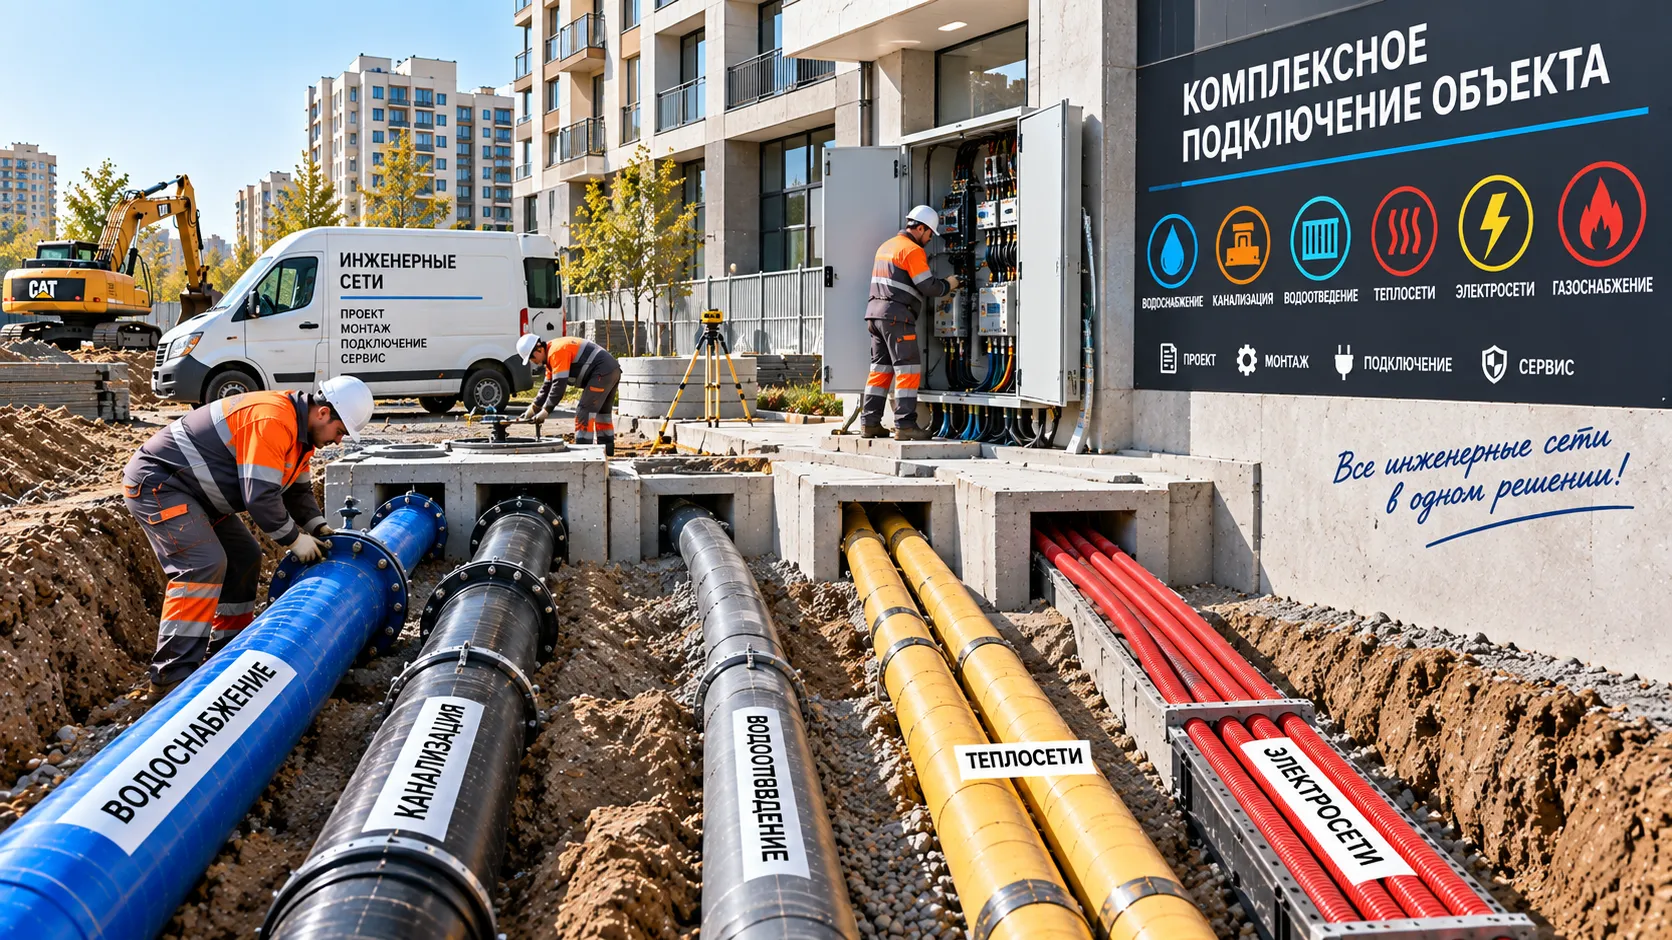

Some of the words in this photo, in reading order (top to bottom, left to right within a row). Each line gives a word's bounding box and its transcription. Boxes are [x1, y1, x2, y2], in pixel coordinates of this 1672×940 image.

[1183, 22, 1428, 116] КОМПЛЕКСНОЕ
[1182, 81, 1422, 163] ПОДКЛЮЧЕНИЕ
[1432, 42, 1611, 116] ОБЪЕКТА
[339, 251, 457, 270] ИНЖЕНЕРНЫЕ
[28, 279, 58, 299] CAT
[340, 273, 384, 290] СЕТИ
[1455, 281, 1535, 299] ЭЛЕКТРОСЕТИ
[1552, 276, 1654, 296] ГАЗОСНАБЖЕНИЕ
[1212, 292, 1274, 307] КАНАЛИЗАЦИЯ
[1283, 288, 1359, 306] ВОДООТВЕДЕНИЕ
[1373, 285, 1436, 301] ТЕПЛОСЕТИ
[340, 308, 385, 320] ПРОЕКТ
[340, 323, 391, 334] МОНТАЖ
[340, 337, 428, 351] ПОДКЛЮЧЕНИЕ
[340, 352, 386, 364] СЕРВИС
[1183, 353, 1217, 366] ПРОЕКТ
[1264, 354, 1310, 369] МОНТАЖ
[1364, 355, 1453, 373] ПОДКЛЮЧЕНИЕ
[1518, 358, 1575, 376] СЕРВИС
[1333, 450, 1375, 485] Все
[1384, 439, 1532, 479] инженерные
[1543, 426, 1611, 455] сети
[1385, 481, 1405, 514] в
[1409, 484, 1485, 525] одном
[1489, 452, 1631, 514] решении!
[100, 661, 277, 825] ВОДОСНАБЖЕНИЕ
[393, 703, 466, 821] КАНАЛИЗАЦИЯ
[965, 747, 1083, 769] ТЕПЛОСЕТИ
[1263, 747, 1384, 866] ЭЛЕКТРОСЕТИ
